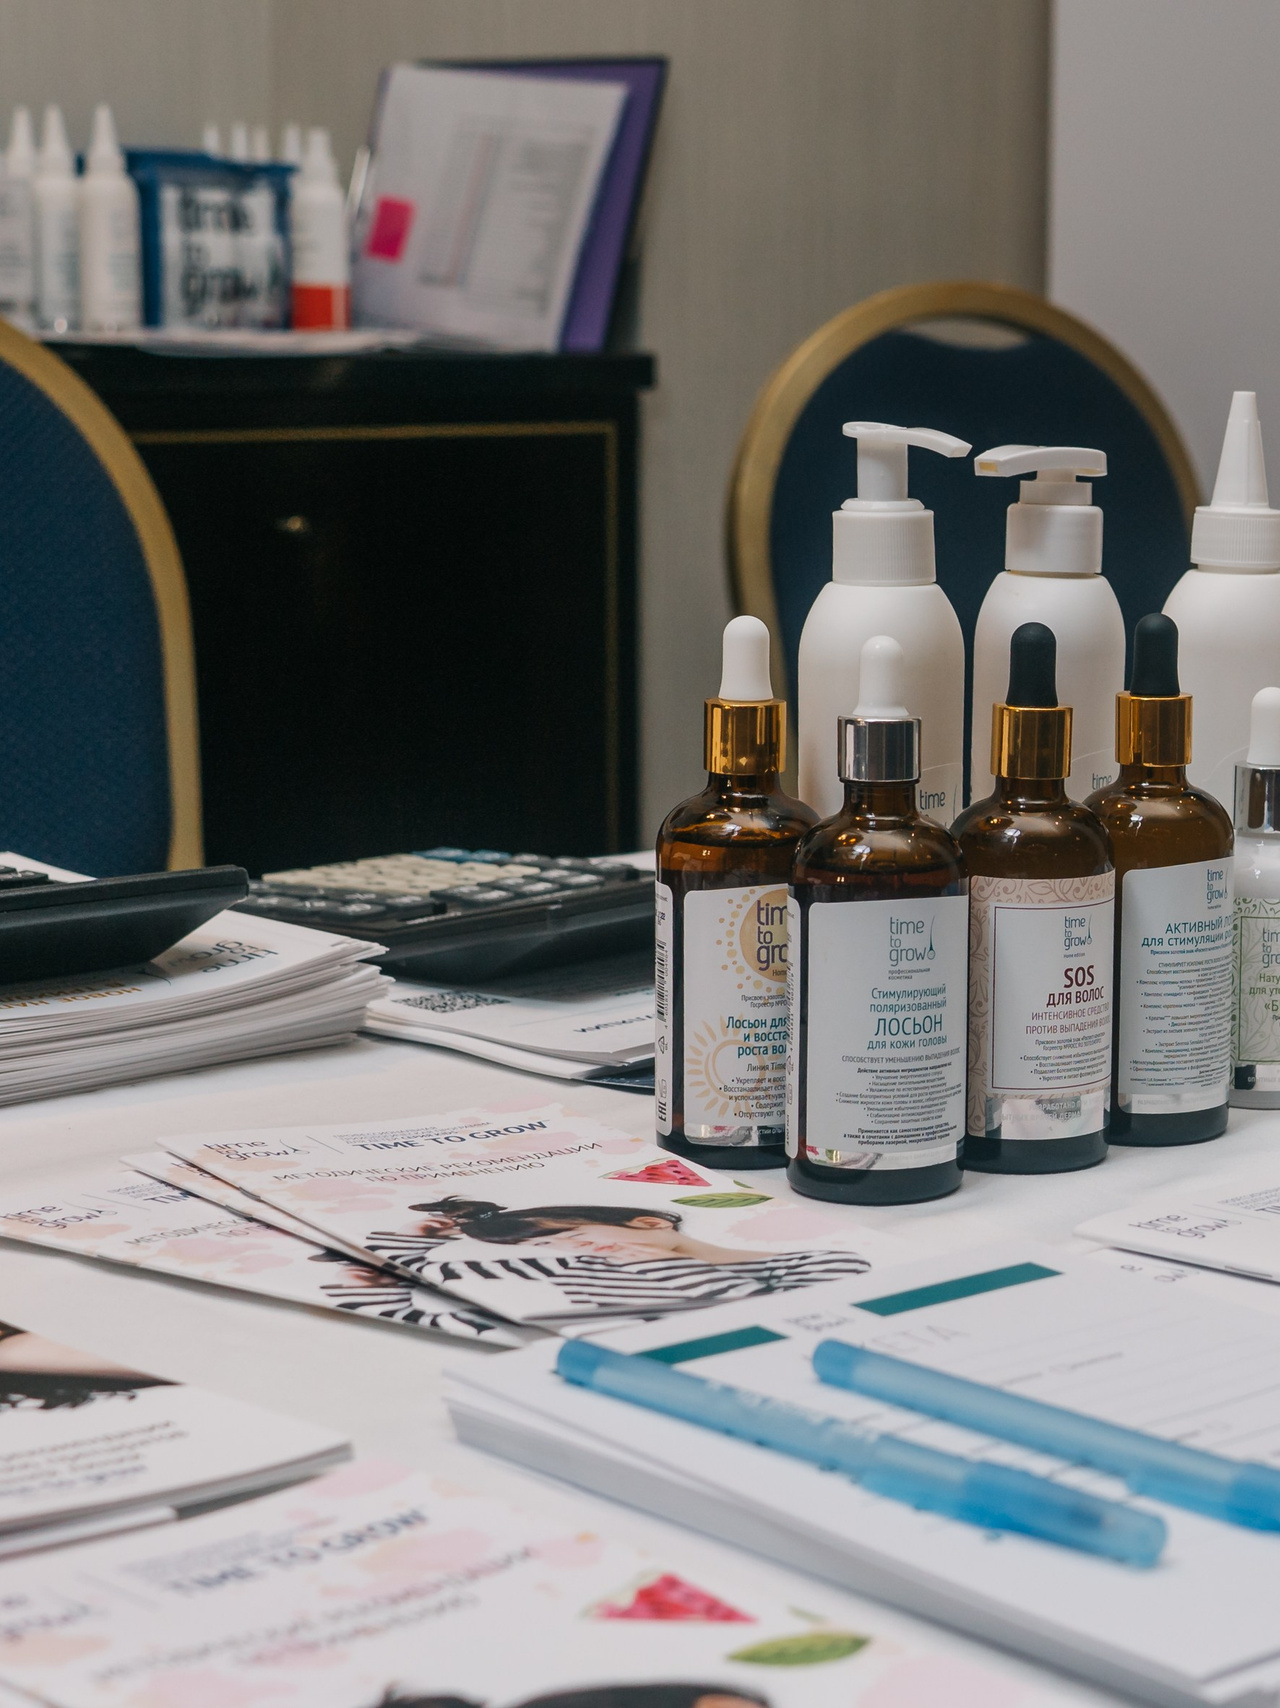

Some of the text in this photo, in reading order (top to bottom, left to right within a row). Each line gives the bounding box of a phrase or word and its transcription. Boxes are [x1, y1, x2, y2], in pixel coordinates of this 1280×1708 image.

[919, 789, 946, 810] time
[1207, 869, 1224, 881] time
[1206, 889, 1224, 904] grow
[890, 917, 925, 934] time
[1064, 916, 1086, 928] time
[1165, 917, 1223, 934] АКТИВНЫЙ
[757, 926, 773, 945] to
[1064, 929, 1072, 938] to
[1142, 937, 1164, 948] для
[1167, 933, 1224, 947] стимуляции
[890, 935, 902, 948] to
[1064, 936, 1087, 951] grow
[1262, 943, 1272, 953] to
[202, 949, 279, 973] time
[889, 947, 927, 967] grow
[1063, 965, 1095, 989] SOS
[871, 983, 946, 1001] Стимулирующий
[1046, 986, 1105, 1008] ДЛЯ ВОЛОС
[1249, 987, 1266, 996] для
[870, 997, 947, 1015] поляризованный
[726, 1016, 767, 1029] Лосьон
[1031, 1010, 1086, 1021] ИНТЕНСИВНОЕ
[874, 1014, 943, 1036] ЛОСЬОН
[1025, 1023, 1058, 1035] ПРОТИВ
[1059, 1021, 1099, 1033] ВЫПАДЕНИЯ
[743, 1033, 750, 1042] и
[867, 1035, 947, 1050] для кожи головы
[738, 1046, 768, 1059] роста
[842, 1055, 884, 1064] СПОСОБСТВУЕТ
[885, 1055, 925, 1064] УМЕНЬШЕНИЮ
[747, 1064, 769, 1072] Линия
[352, 1139, 411, 1152] TIME
[415, 1134, 458, 1147] TO
[468, 1120, 547, 1142] GROW
[202, 1140, 269, 1151] time
[225, 1146, 291, 1161] grow
[272, 1142, 604, 1182] МЕТОДИЧЕСКИЕ РЕКОМЕНДАЦИИ
[365, 1161, 546, 1183] ПО ПРИМЕНЕНИЮ
[0, 1204, 63, 1220] time
[38, 1212, 100, 1230] grow
[1128, 1213, 1188, 1233] time
[216, 1227, 250, 1239] ПО
[1177, 1219, 1230, 1239] grow
